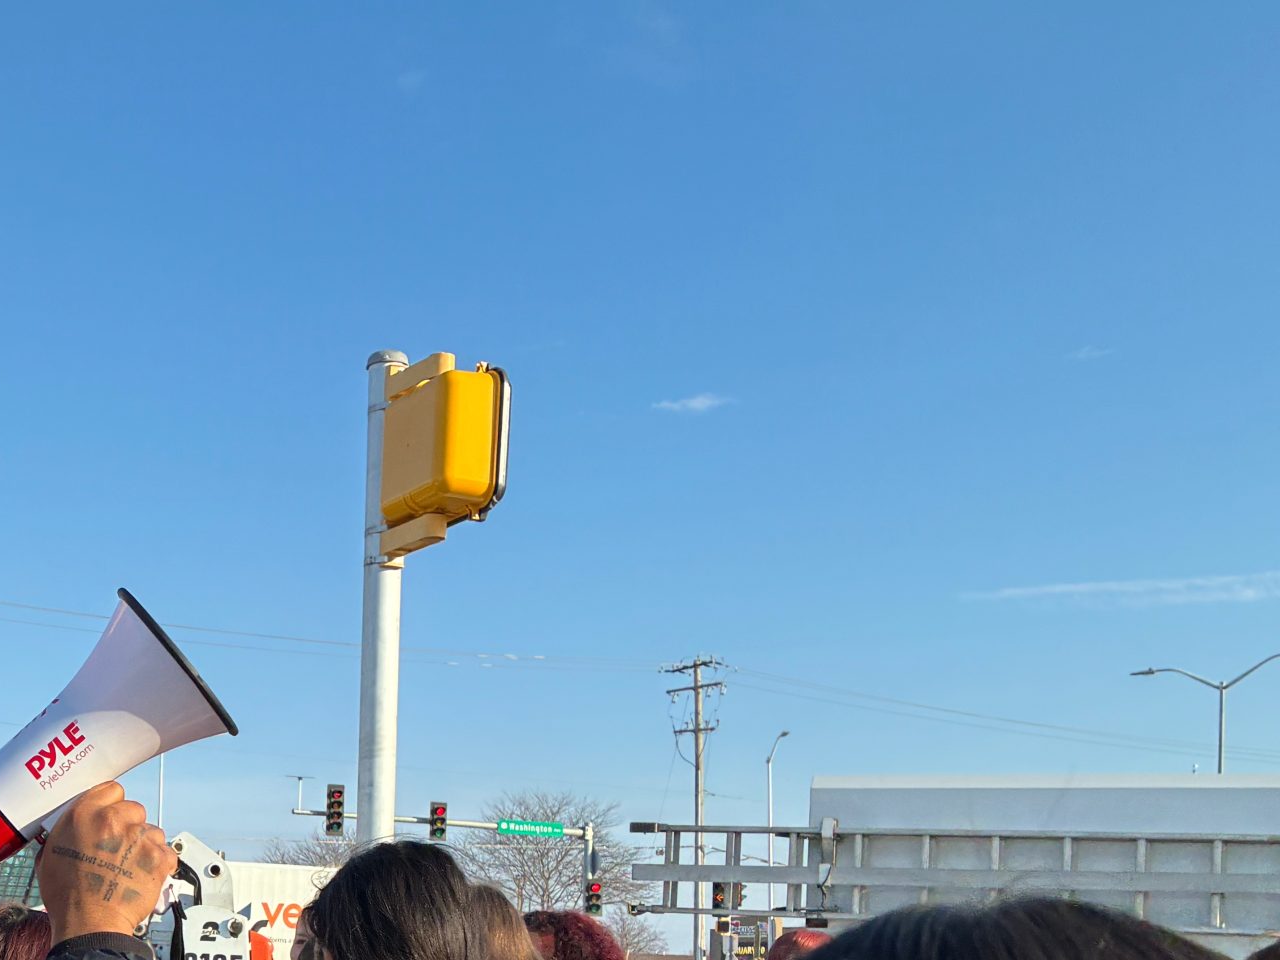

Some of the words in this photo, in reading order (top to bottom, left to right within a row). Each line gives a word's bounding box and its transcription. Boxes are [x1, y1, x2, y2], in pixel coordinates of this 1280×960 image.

[24, 721, 86, 781] PYLE
[39, 743, 95, 791] PyleUSA.com
[509, 822, 553, 835] Washington
[261, 902, 302, 929] ve
